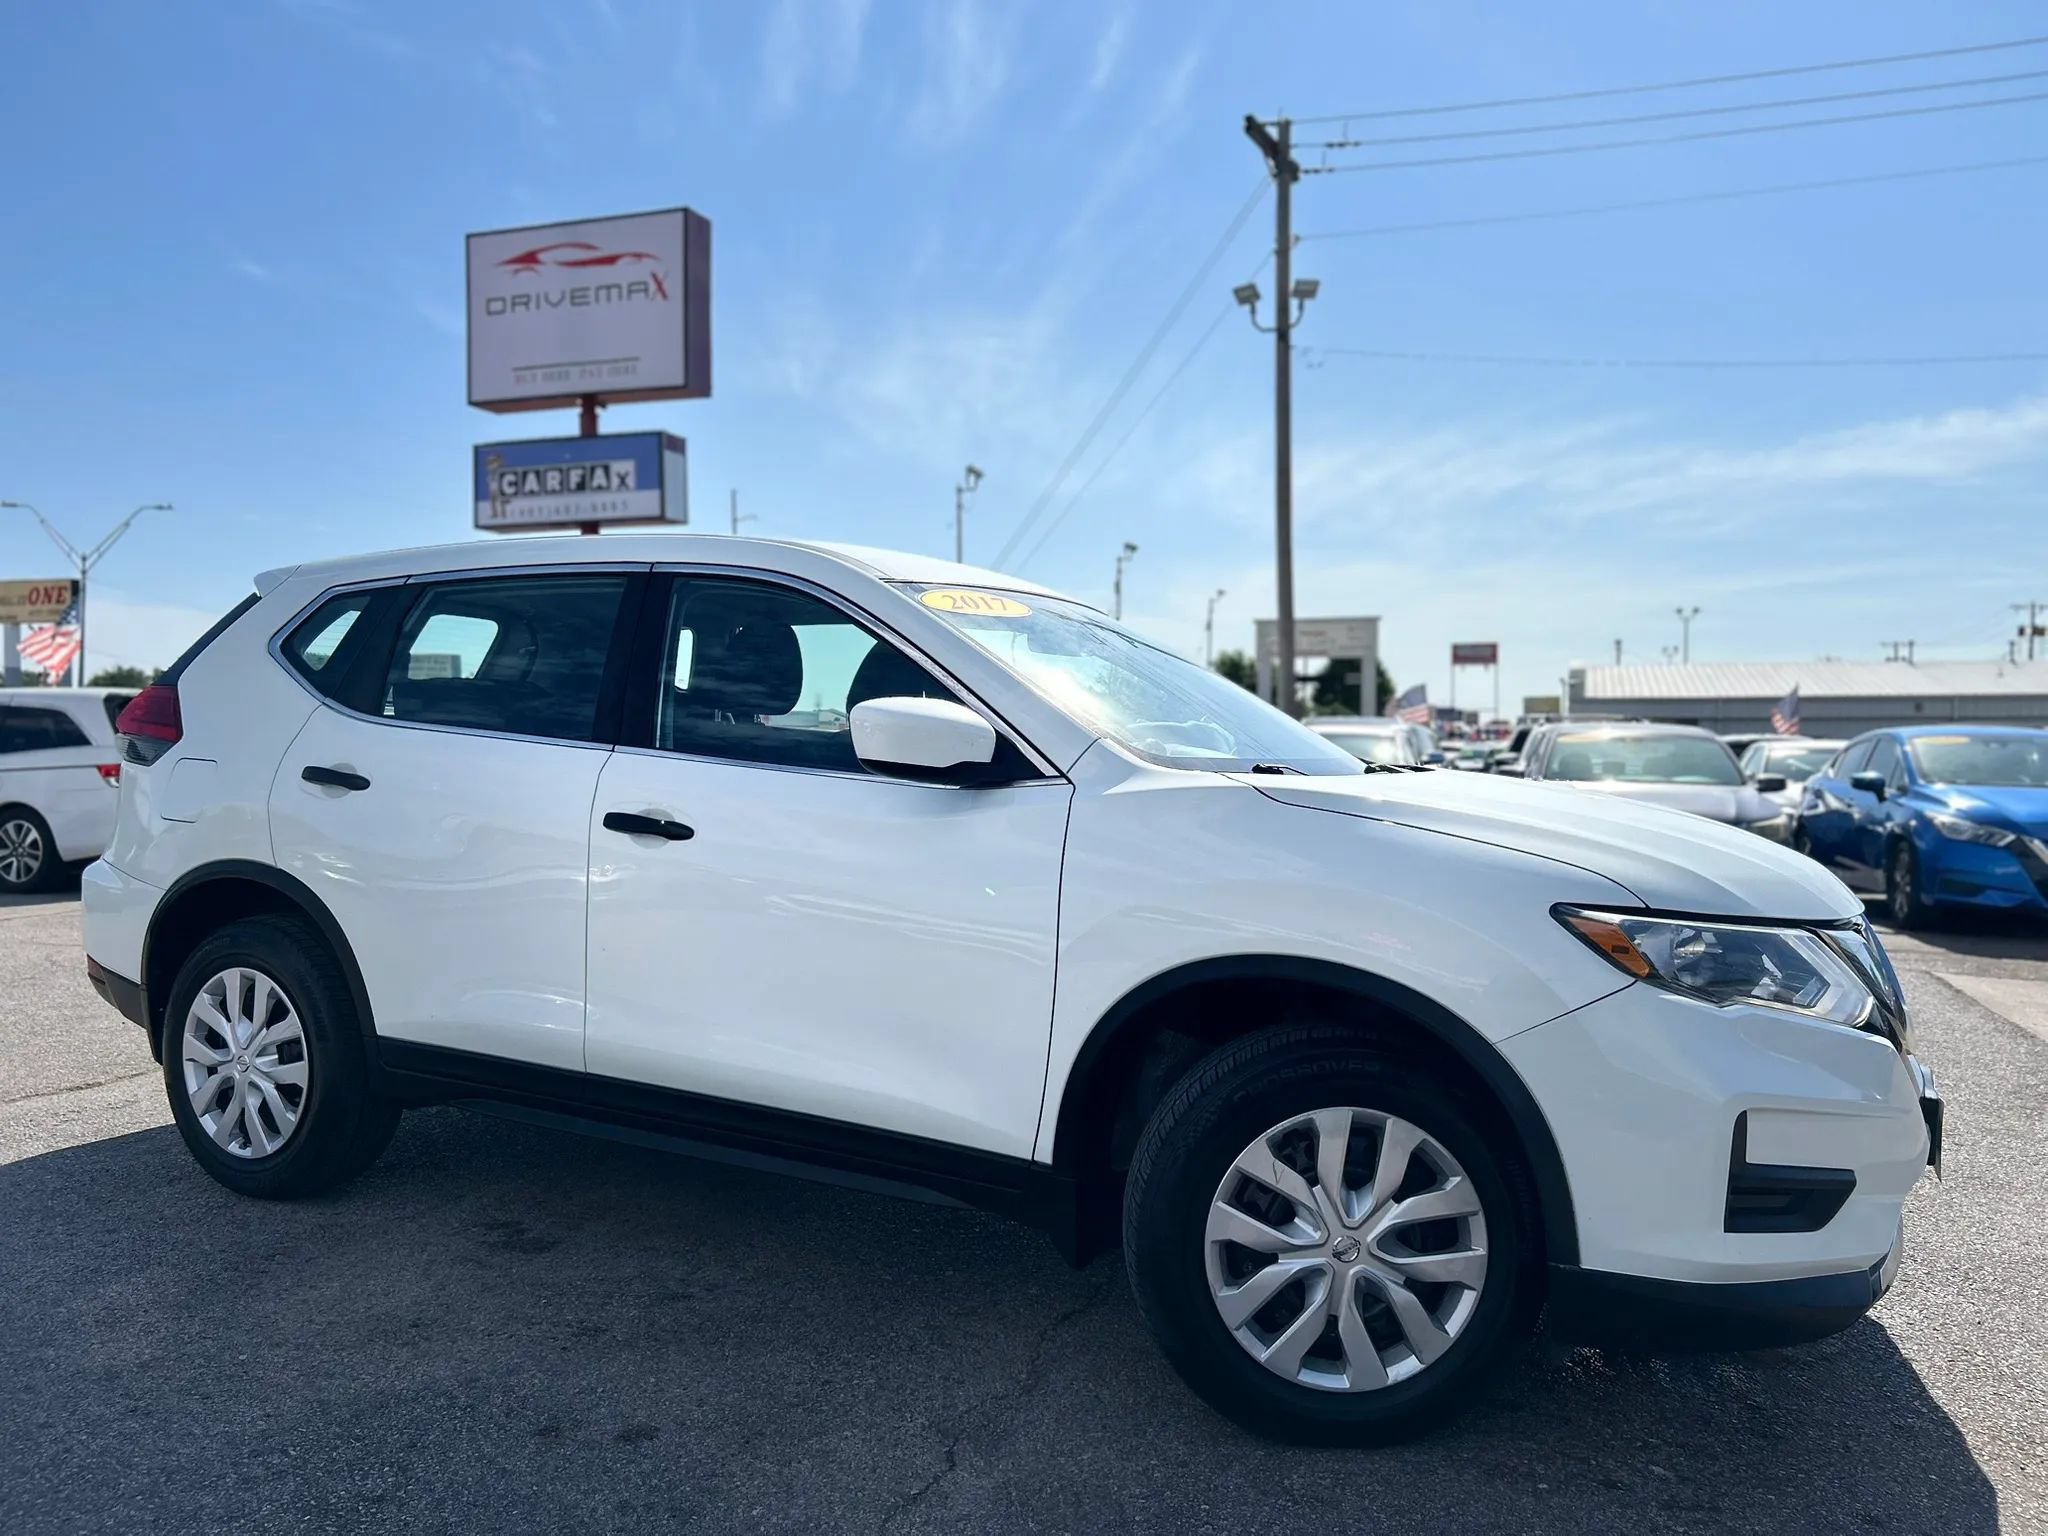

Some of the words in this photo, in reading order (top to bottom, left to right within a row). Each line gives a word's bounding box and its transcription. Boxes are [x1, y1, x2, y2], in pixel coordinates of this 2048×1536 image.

[485, 271, 669, 316] DRIVEMAX
[27, 585, 68, 606] ONE
[941, 594, 1008, 612] 2017
